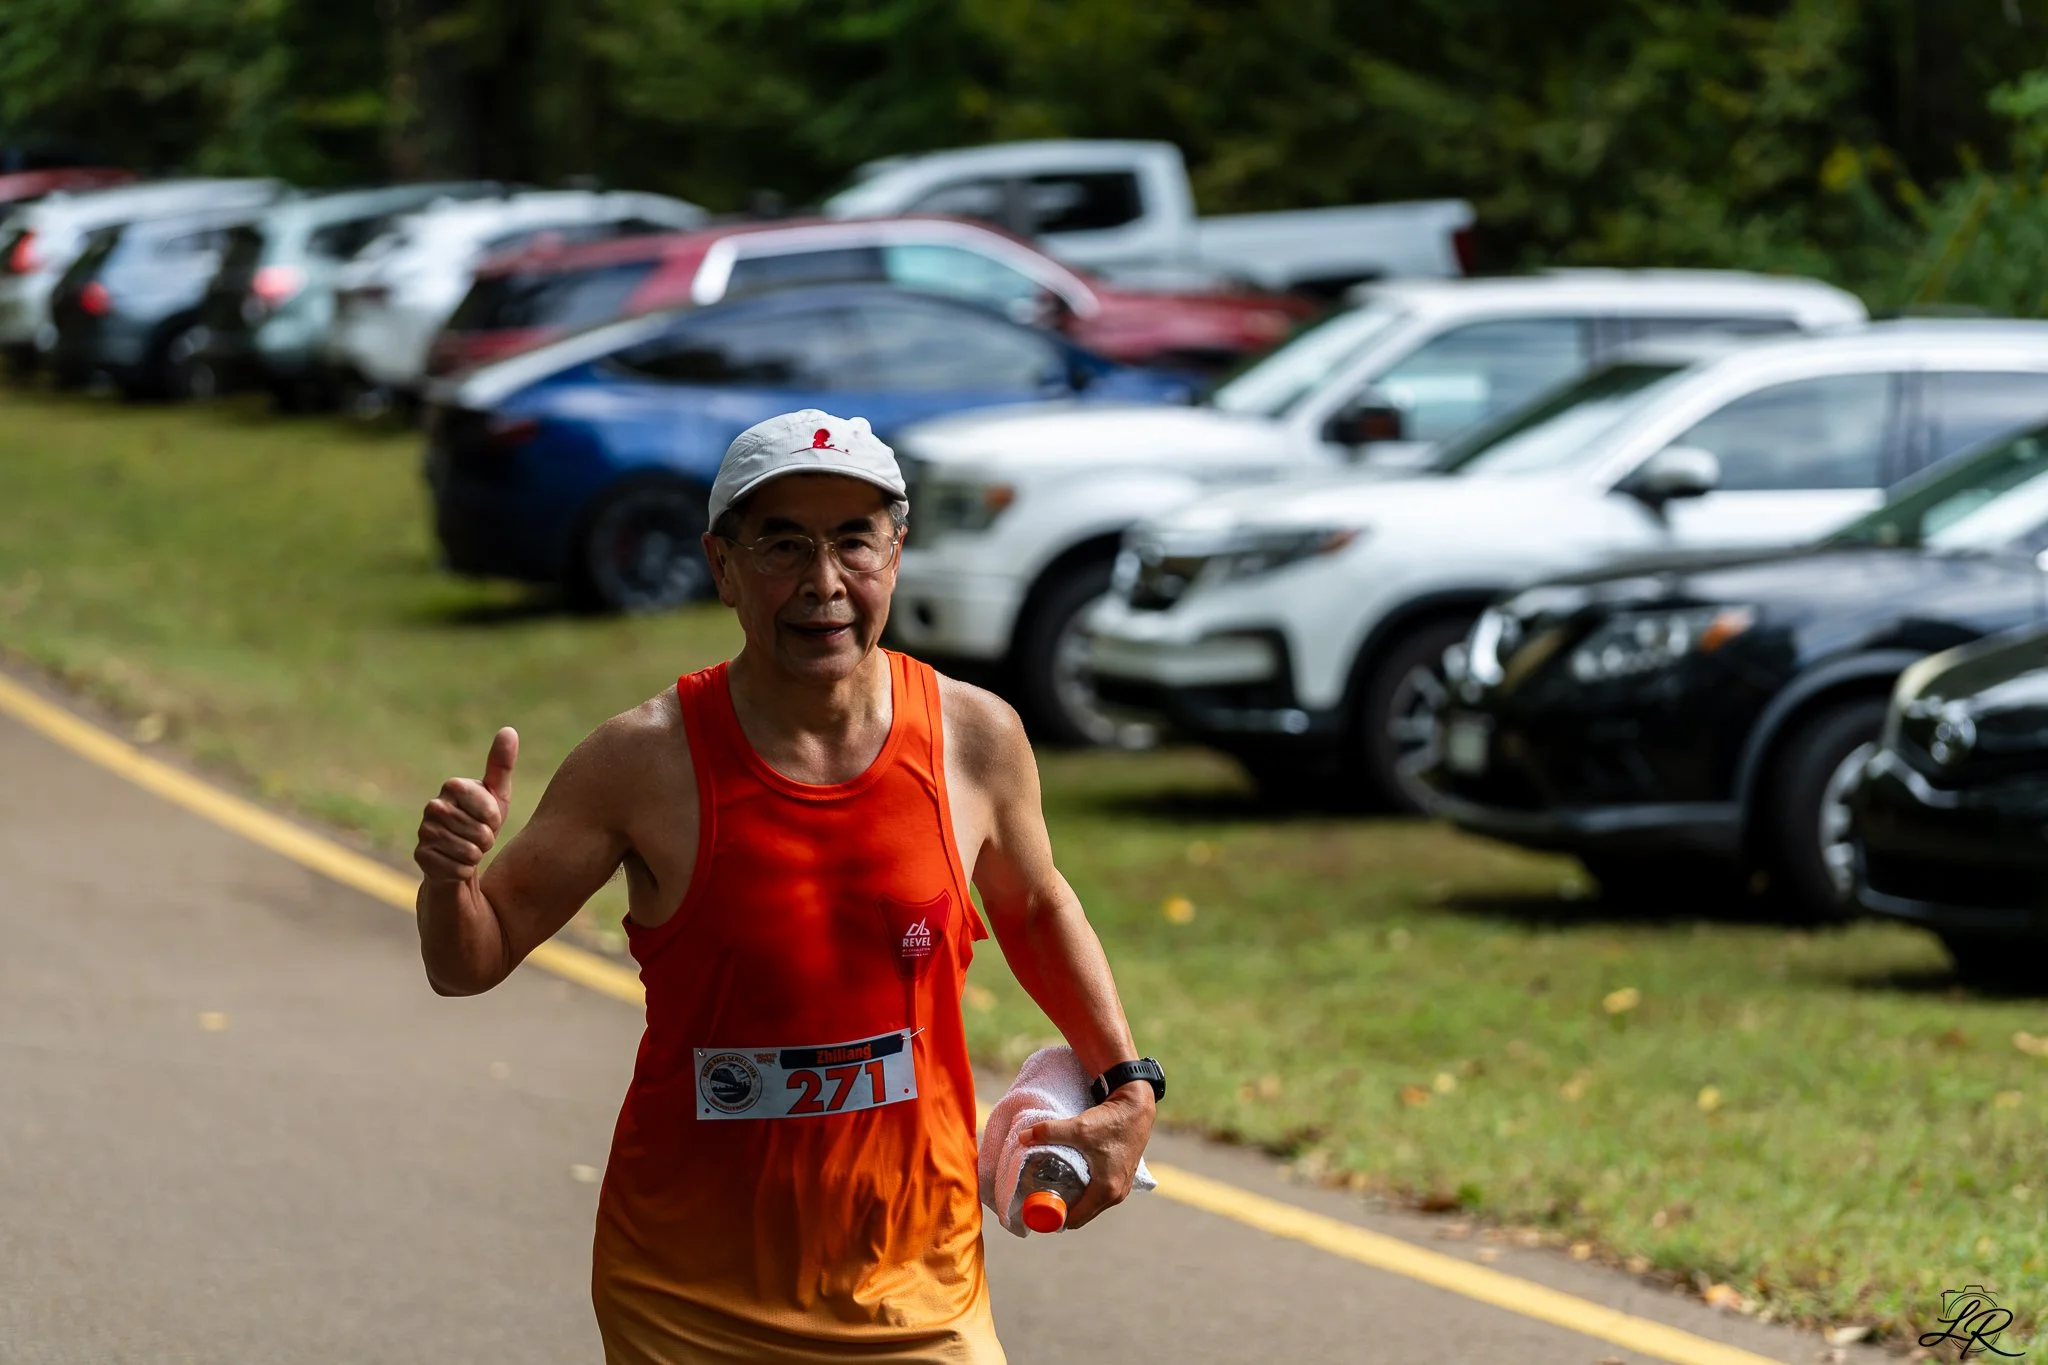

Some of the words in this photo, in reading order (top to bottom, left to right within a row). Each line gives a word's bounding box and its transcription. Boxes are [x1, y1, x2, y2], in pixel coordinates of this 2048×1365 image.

[902, 935, 931, 947] REVEL
[727, 1055, 747, 1066] SERIES
[816, 1043, 872, 1065] Zhiliang
[786, 1059, 886, 1115] 271
